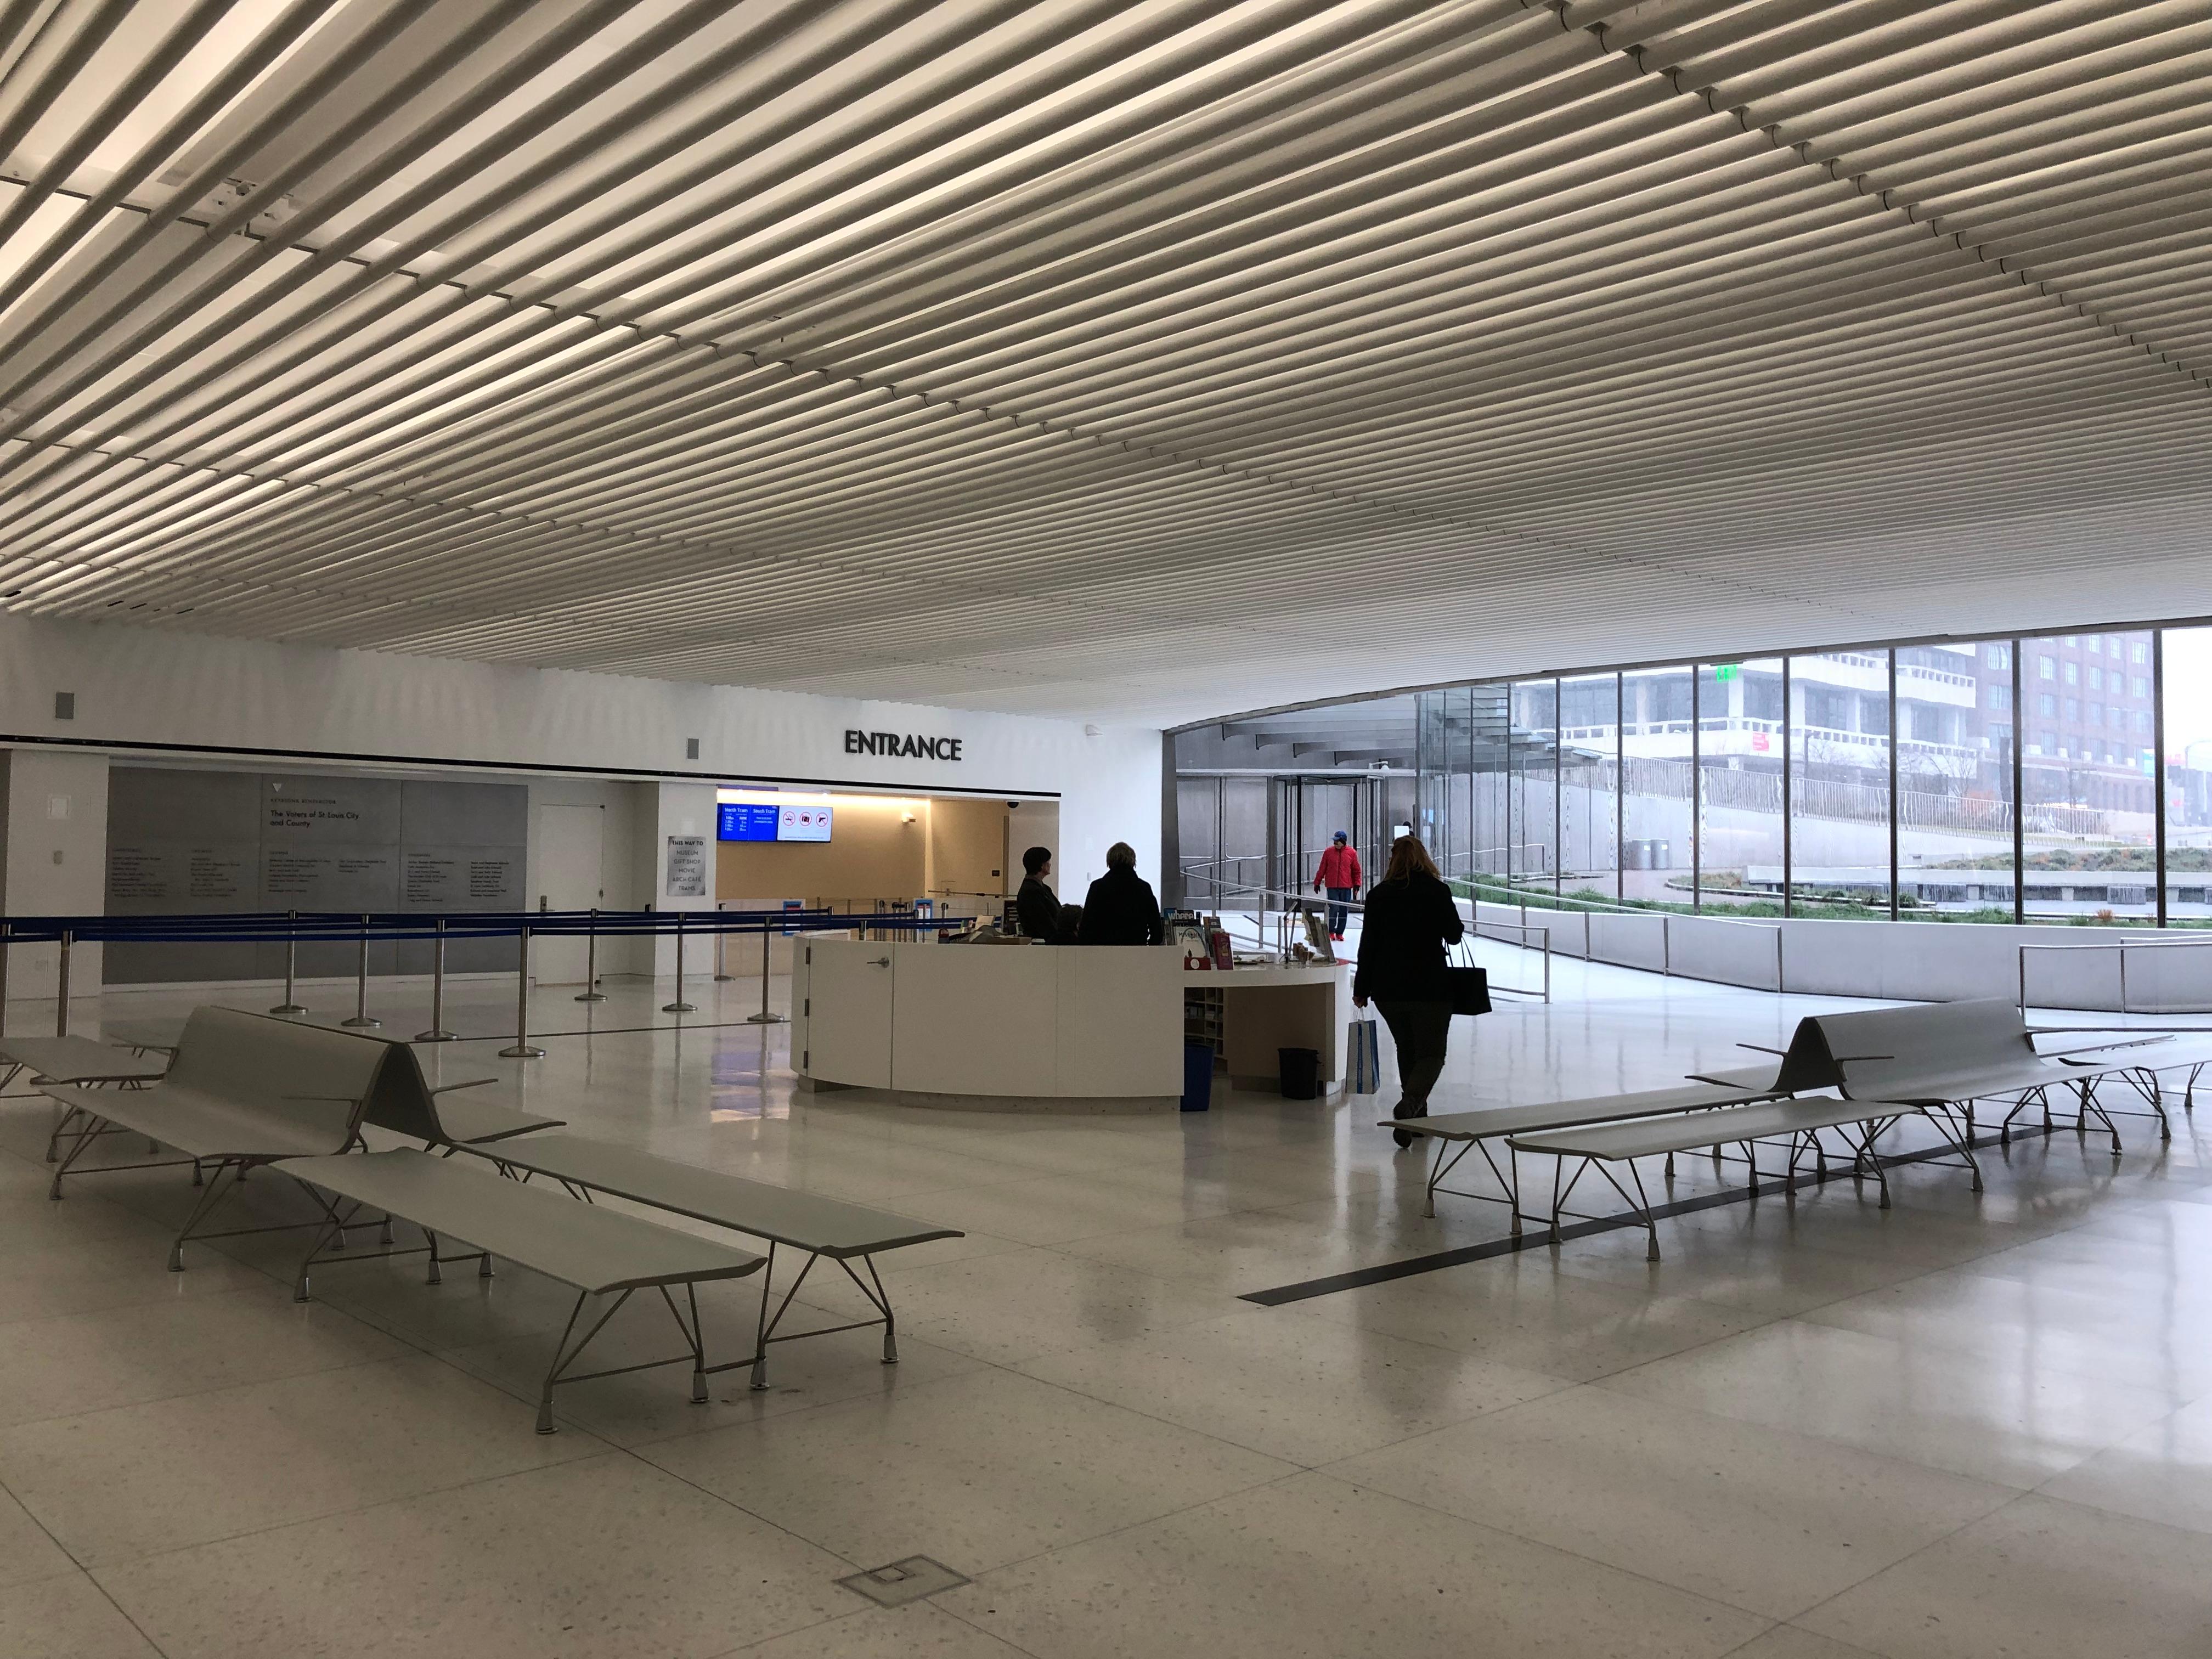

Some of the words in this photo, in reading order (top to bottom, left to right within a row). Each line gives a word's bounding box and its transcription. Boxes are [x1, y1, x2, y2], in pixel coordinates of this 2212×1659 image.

[845, 730, 962, 761] ENTRANCE
[346, 812, 359, 820] City
[286, 820, 311, 828] County
[1167, 910, 1194, 919] where
